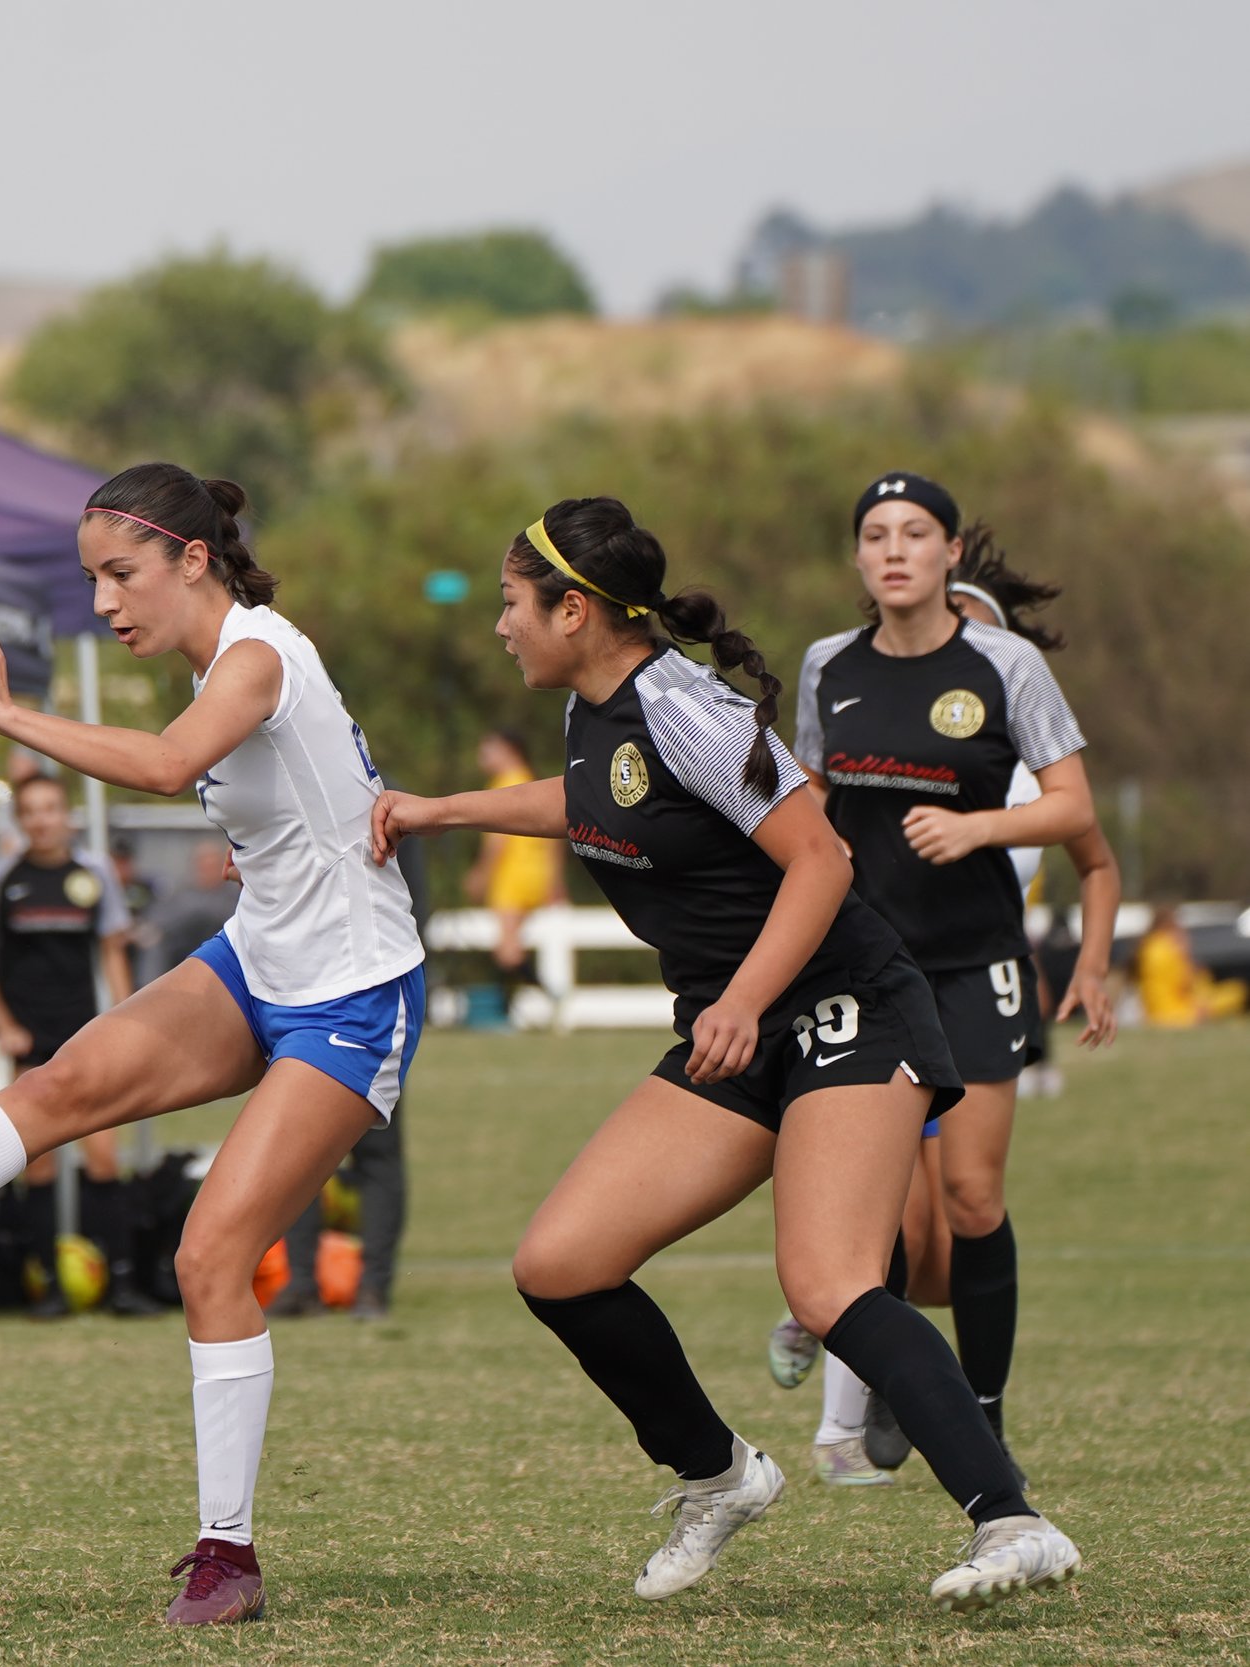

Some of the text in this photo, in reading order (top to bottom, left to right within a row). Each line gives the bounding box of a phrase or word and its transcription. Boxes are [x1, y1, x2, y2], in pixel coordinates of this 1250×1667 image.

[828, 752, 956, 782] California
[632, 780, 648, 801] CLUB
[567, 823, 639, 856] alifornia
[989, 959, 1021, 1017] 9
